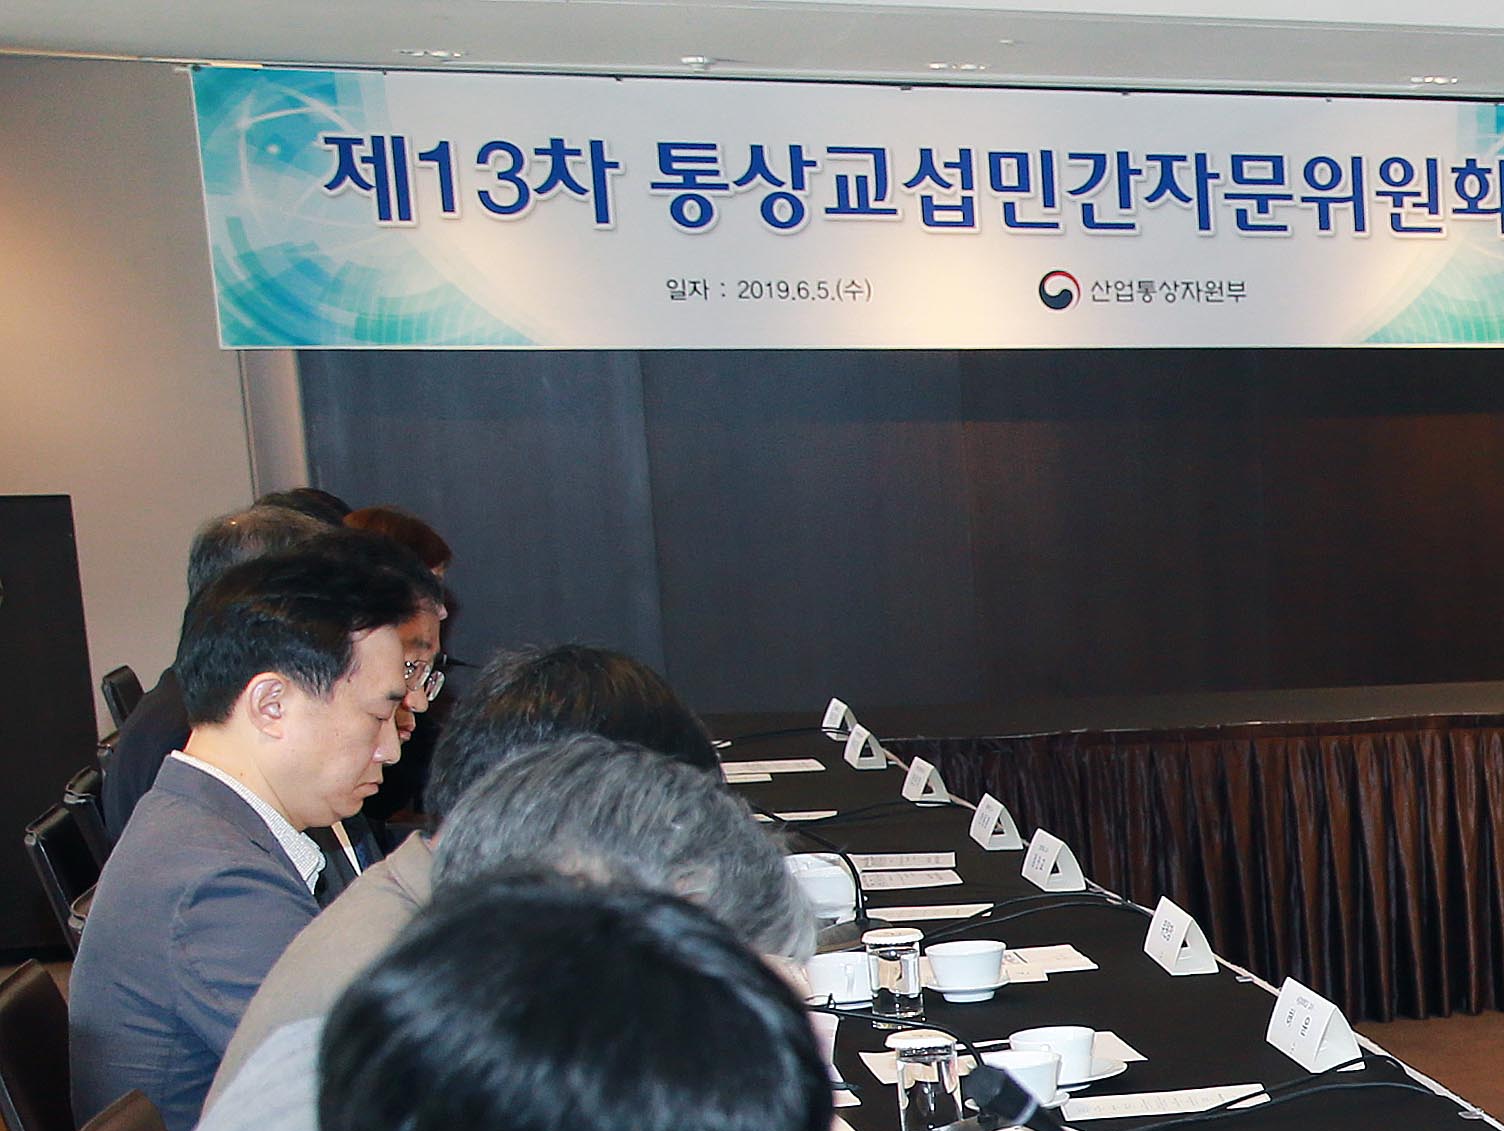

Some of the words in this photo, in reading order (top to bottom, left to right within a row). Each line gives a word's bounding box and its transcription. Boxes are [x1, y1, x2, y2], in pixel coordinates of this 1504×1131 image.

[322, 133, 622, 226] 제13차
[665, 277, 711, 302] 일자
[1089, 276, 1248, 306] 산업통상자원부
